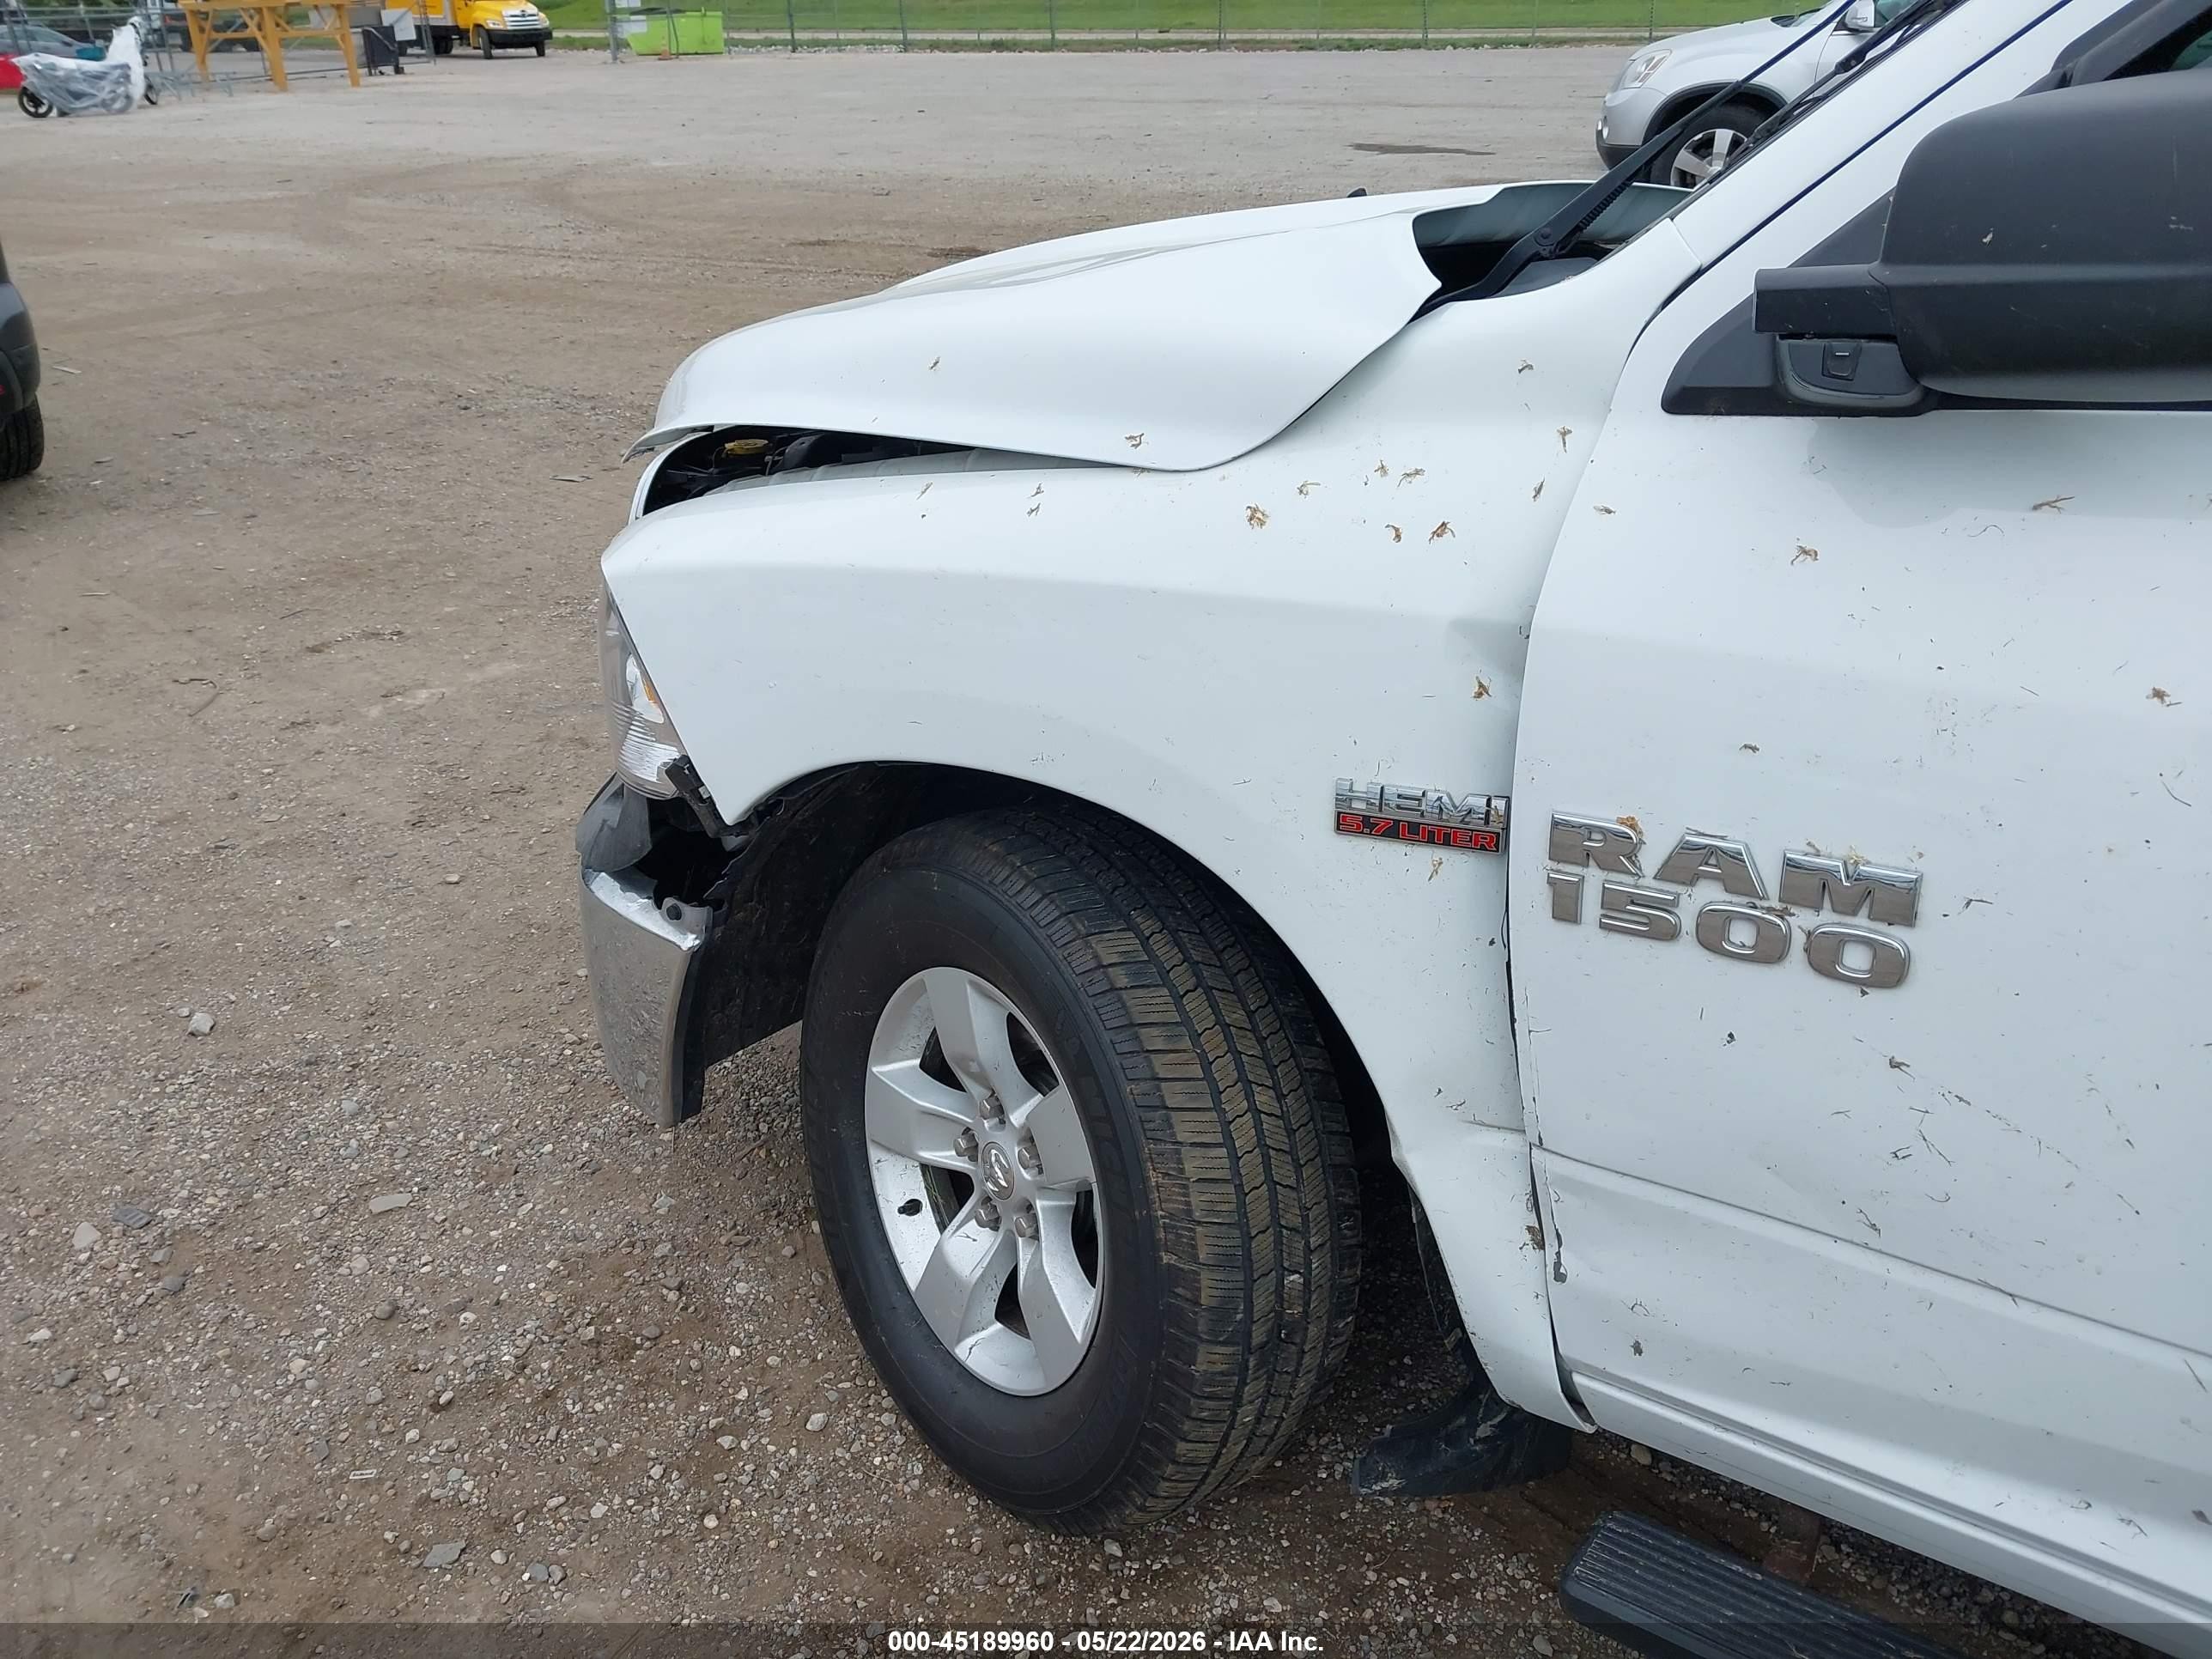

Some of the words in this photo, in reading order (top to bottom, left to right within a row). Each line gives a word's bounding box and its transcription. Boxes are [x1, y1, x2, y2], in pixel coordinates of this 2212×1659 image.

[1334, 778, 1510, 829] HEMI
[1339, 812, 1394, 836] 5.7
[1399, 821, 1497, 852] LITER
[1548, 810, 1923, 928] RAM
[1547, 871, 1911, 988] 1500
